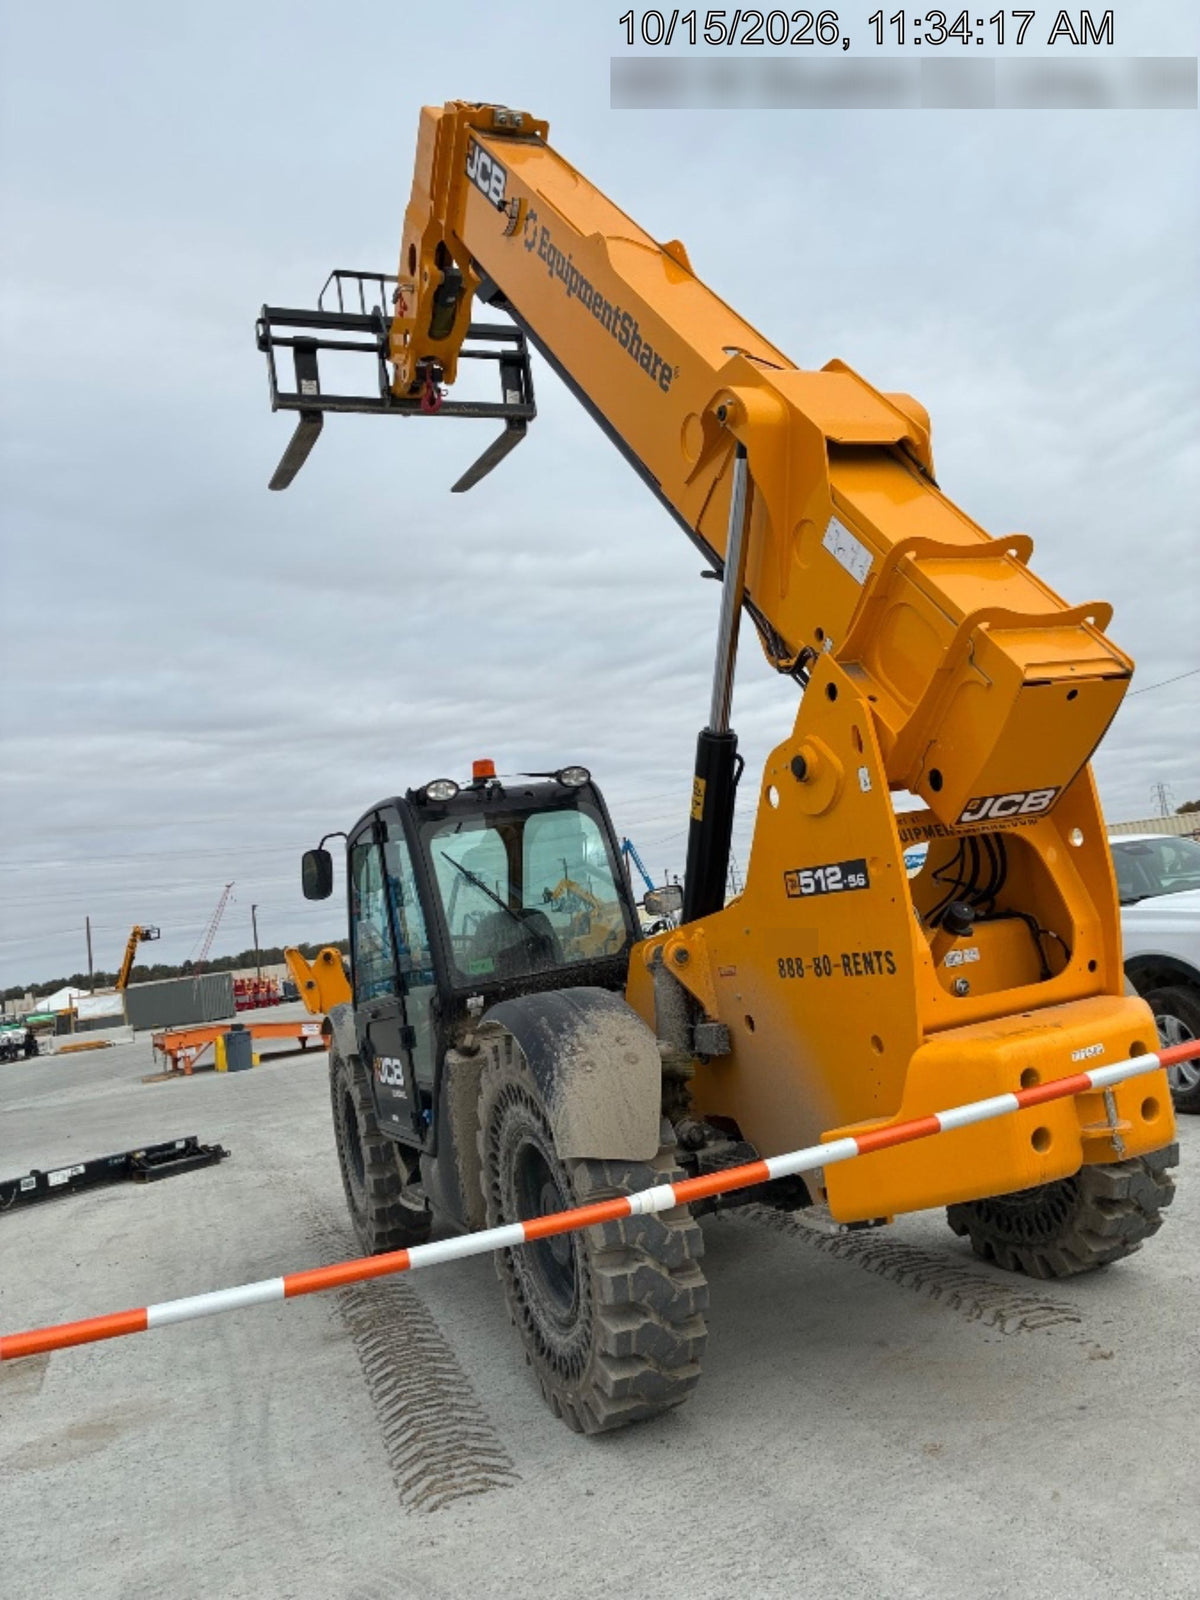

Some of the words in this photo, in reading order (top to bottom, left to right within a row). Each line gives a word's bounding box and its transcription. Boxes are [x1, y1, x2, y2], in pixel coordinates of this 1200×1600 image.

[466, 144, 506, 206] JCB
[536, 225, 674, 394] EquipmentShare
[960, 788, 1056, 823] JCB
[777, 949, 897, 979] 888-80-RENTS
[381, 1057, 405, 1086] JCB
